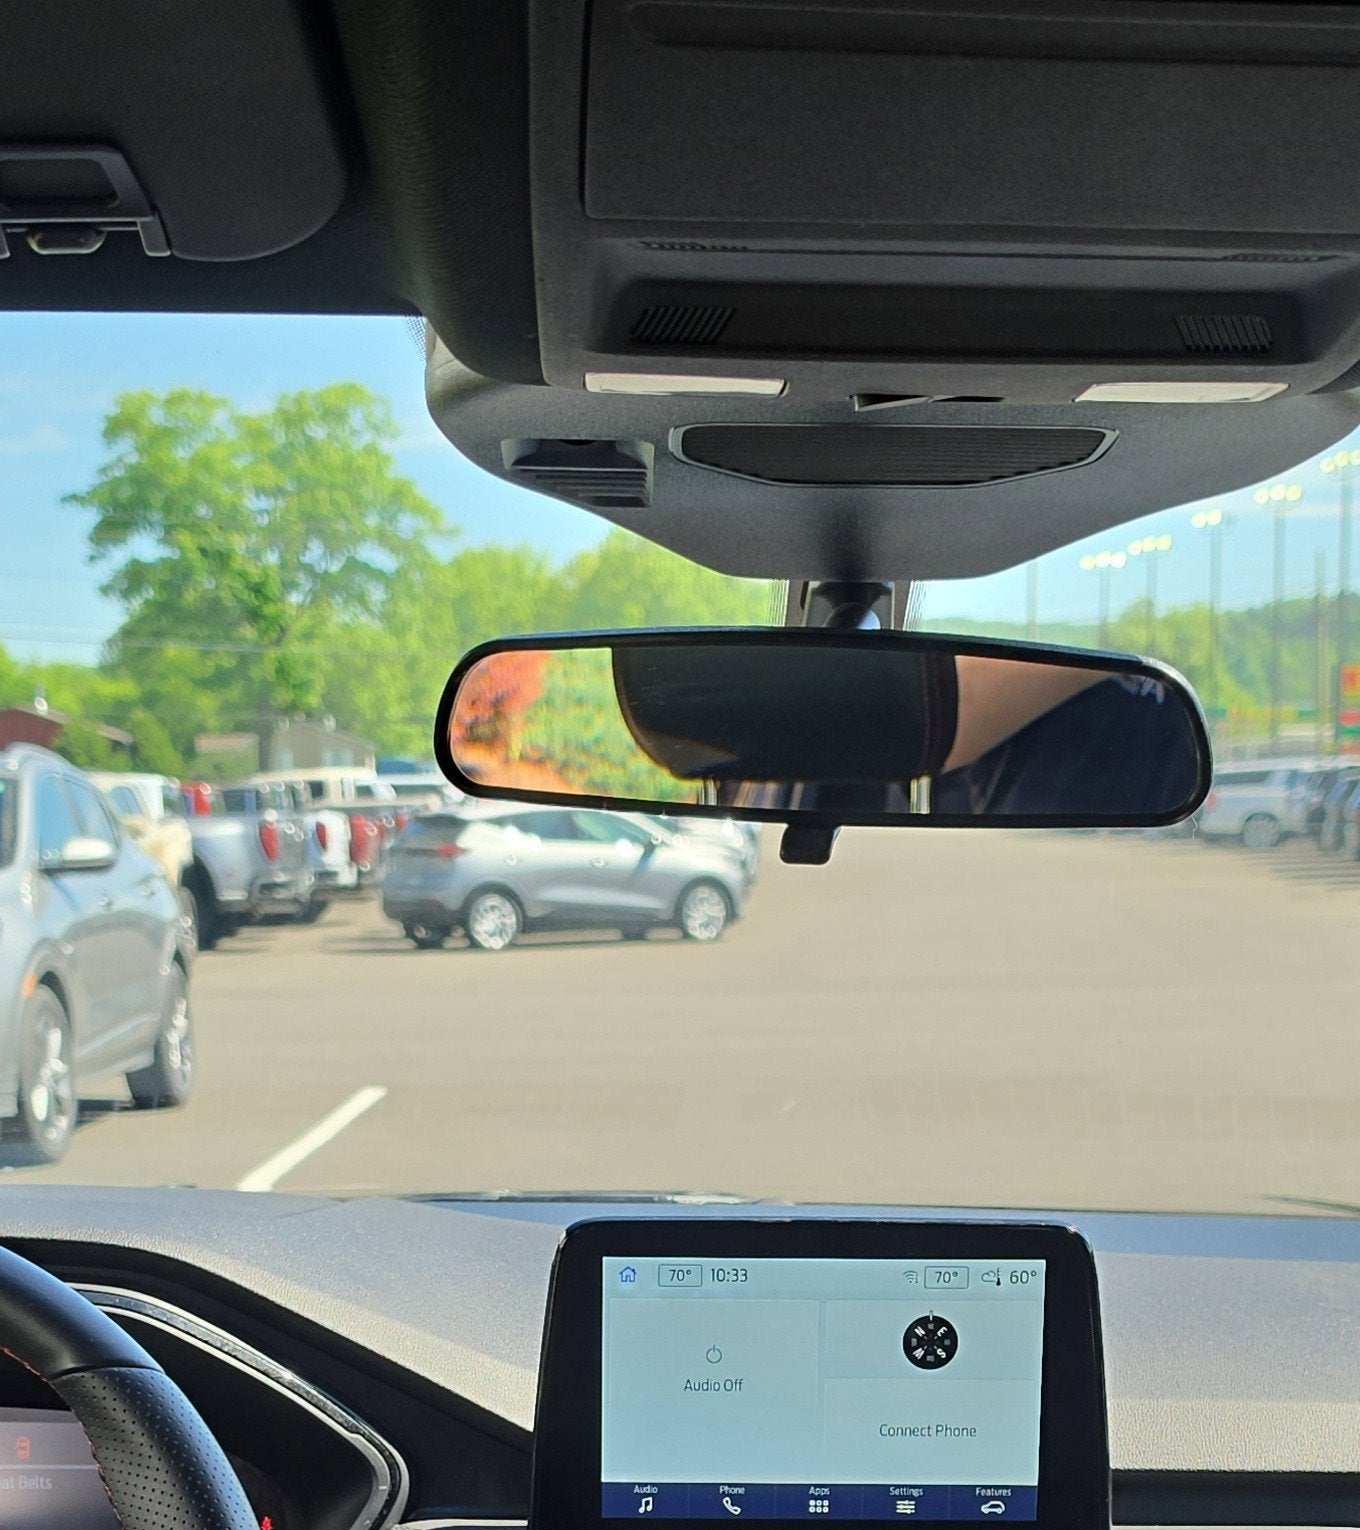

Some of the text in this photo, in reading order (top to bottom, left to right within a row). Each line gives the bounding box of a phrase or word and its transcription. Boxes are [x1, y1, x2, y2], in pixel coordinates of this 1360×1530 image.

[668, 1268, 693, 1282] 70°
[710, 1267, 748, 1283] 10:33
[934, 1270, 959, 1284] 70°
[1009, 1269, 1038, 1285] 60°
[914, 1325, 926, 1337] N
[937, 1326, 948, 1337] E
[937, 1348, 947, 1359] S
[683, 1377, 743, 1393] Audio Off
[879, 1423, 977, 1439] Connect Phone
[19, 1475, 53, 1490] Belts
[633, 1484, 658, 1495] Audio
[719, 1484, 746, 1495] Phone
[809, 1486, 831, 1498] Apps
[889, 1485, 924, 1498] Settings
[975, 1486, 1012, 1497] Features
